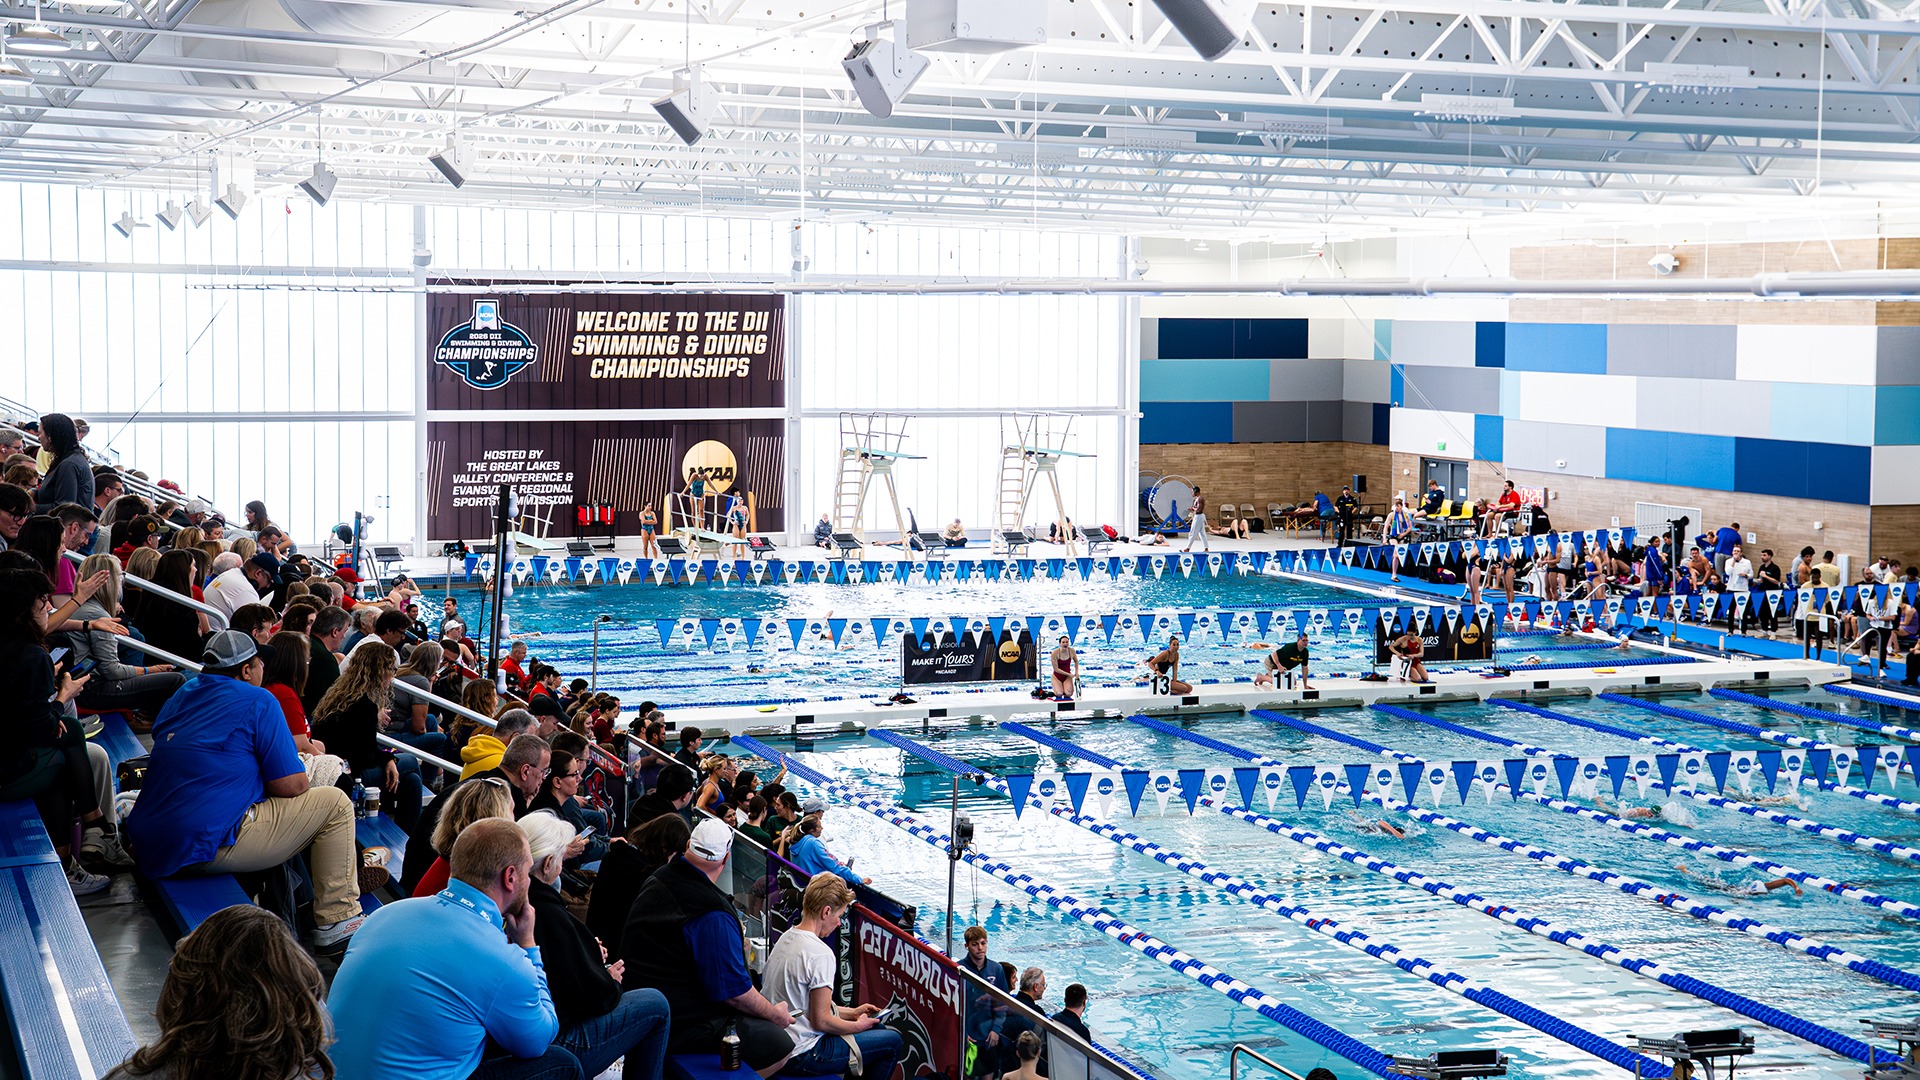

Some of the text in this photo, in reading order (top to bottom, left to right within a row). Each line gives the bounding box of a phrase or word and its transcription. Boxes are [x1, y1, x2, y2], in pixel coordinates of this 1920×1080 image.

[576, 311, 769, 332] WELCOME TO THE DII
[571, 334, 767, 356] SWIMMING & DIVING
[438, 348, 534, 360] CHAMPIONSHIPS
[590, 358, 750, 378] CHAMPIONSHIPS
[484, 450, 544, 460] HOSTED BY
[466, 461, 560, 472] THE GREAT LAKES
[453, 472, 574, 484] VALLEY CONFERENCE &
[453, 484, 573, 495] EVANSVIE REGIONAL
[453, 495, 573, 507] SPORTS MMISSION
[1523, 513, 1530, 524] 4
[912, 658, 934, 666] MAKE
[943, 652, 974, 668] YOURS
[1151, 676, 1169, 695] 13
[1274, 672, 1291, 689] 11
